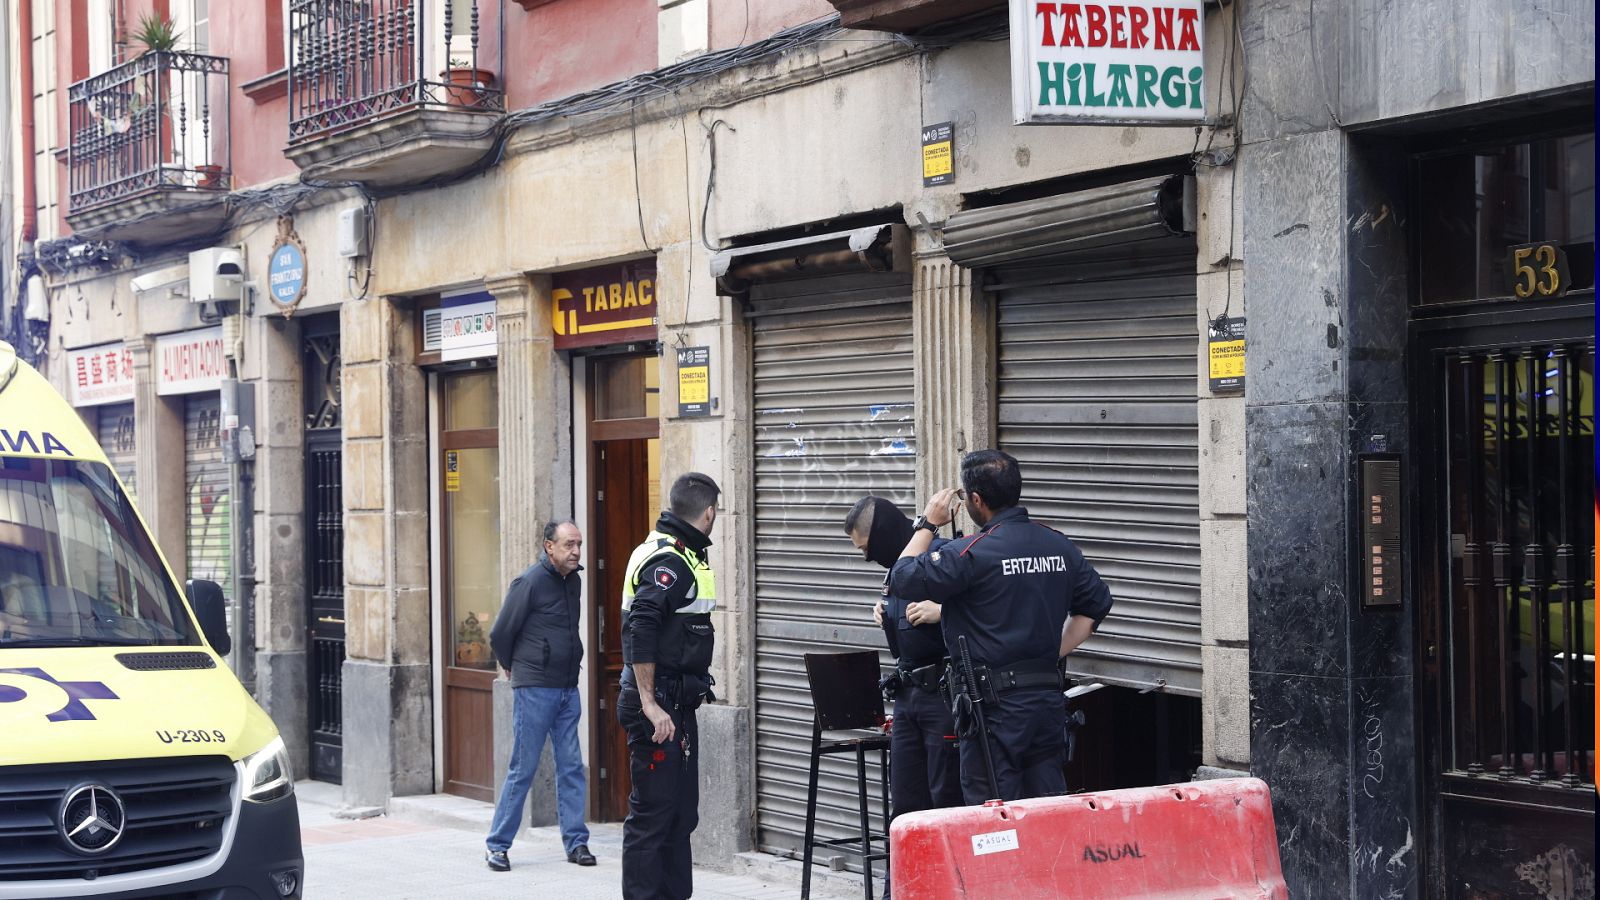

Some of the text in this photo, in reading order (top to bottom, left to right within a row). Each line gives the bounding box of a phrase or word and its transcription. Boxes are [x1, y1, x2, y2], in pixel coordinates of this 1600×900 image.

[1035, 3, 1200, 51] TABERNA
[1513, 243, 1560, 299] 53
[1001, 555, 1067, 577] ERTZAINTZA
[156, 728, 226, 745] U-230.9
[1083, 843, 1146, 863] ASUAL
